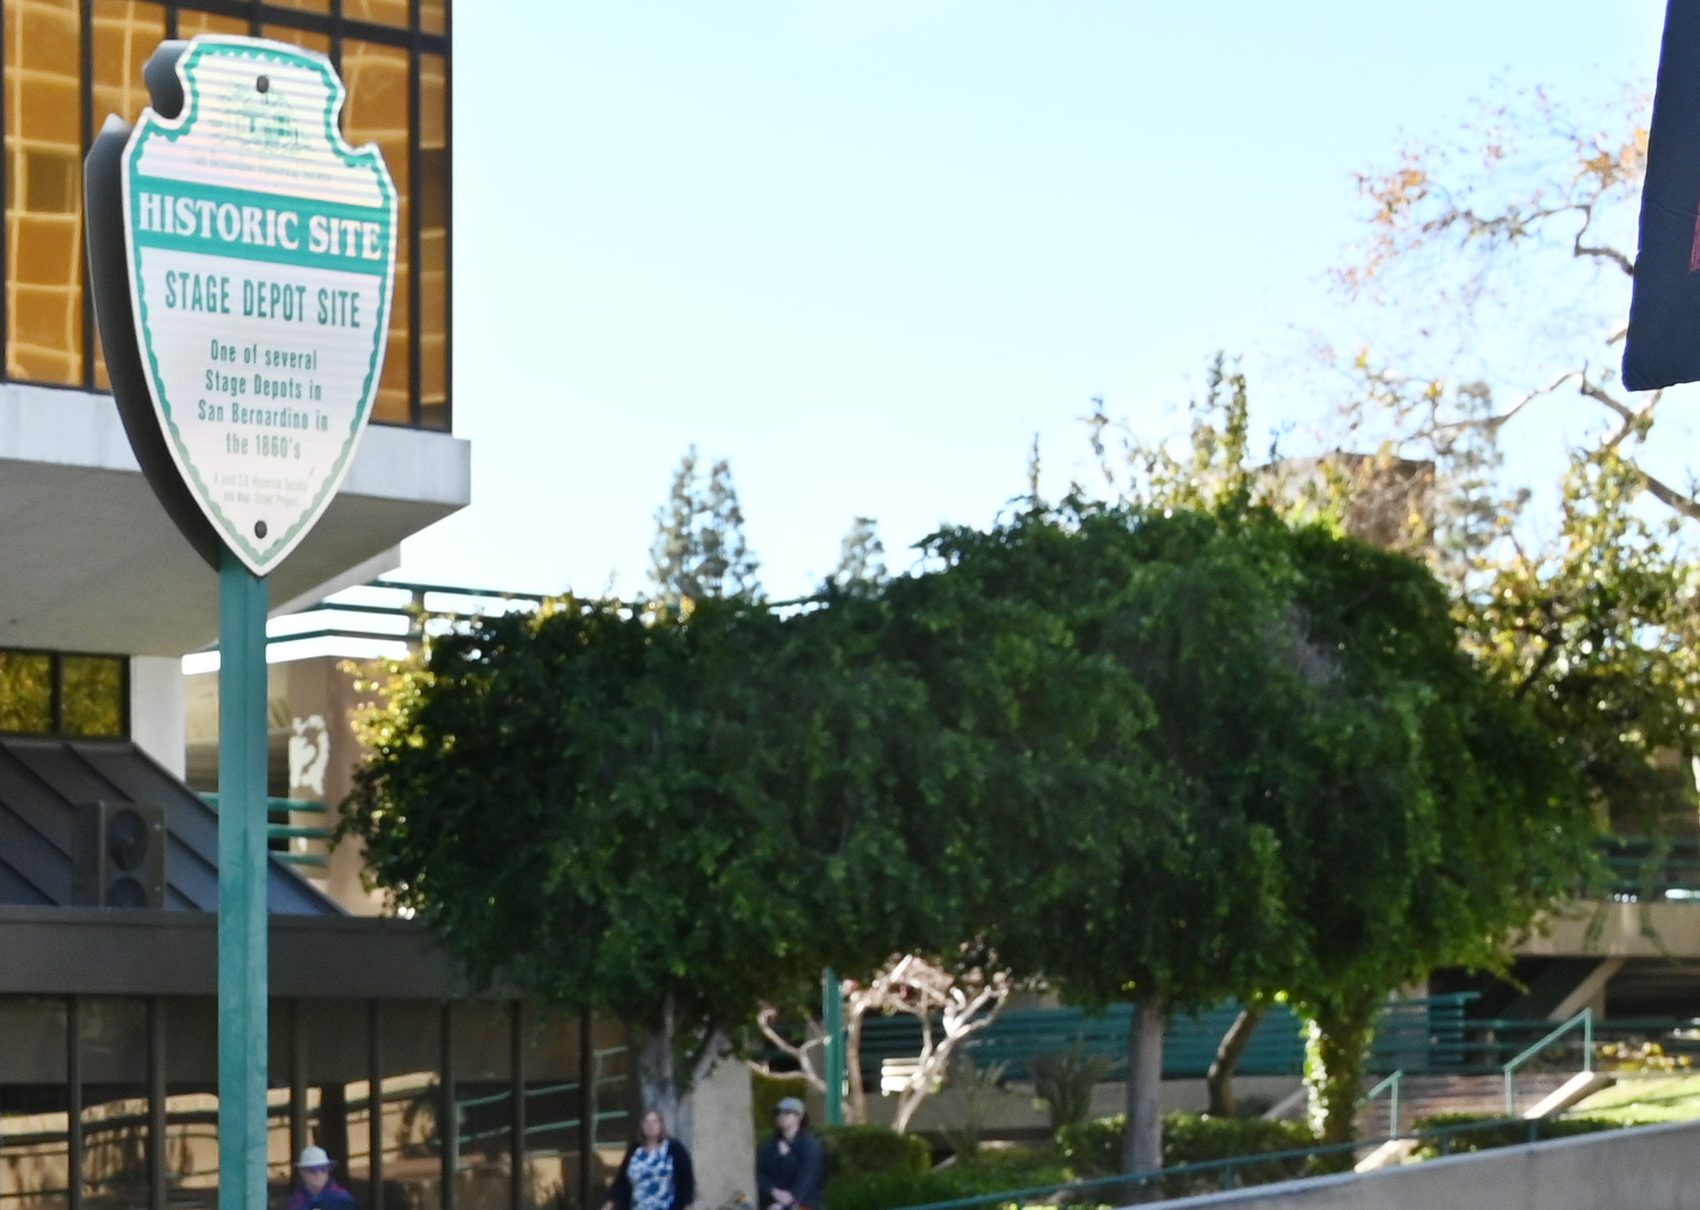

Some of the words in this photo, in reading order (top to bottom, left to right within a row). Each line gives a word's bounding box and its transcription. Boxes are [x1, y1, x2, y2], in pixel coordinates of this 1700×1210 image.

[139, 192, 299, 250] HISTORIC
[309, 215, 383, 260] SITE
[166, 270, 230, 314] STAGE
[244, 279, 306, 322] DEPOT
[318, 288, 360, 328] SITE
[211, 339, 236, 362] One
[244, 343, 257, 364] of
[265, 349, 316, 370] several
[206, 369, 246, 397] Stage
[254, 373, 302, 400] Depots
[309, 379, 322, 401] in
[198, 398, 224, 422] San
[232, 402, 308, 430] Bernardino
[316, 409, 329, 432] in
[226, 432, 248, 455] the
[256, 434, 301, 460] 1860's
